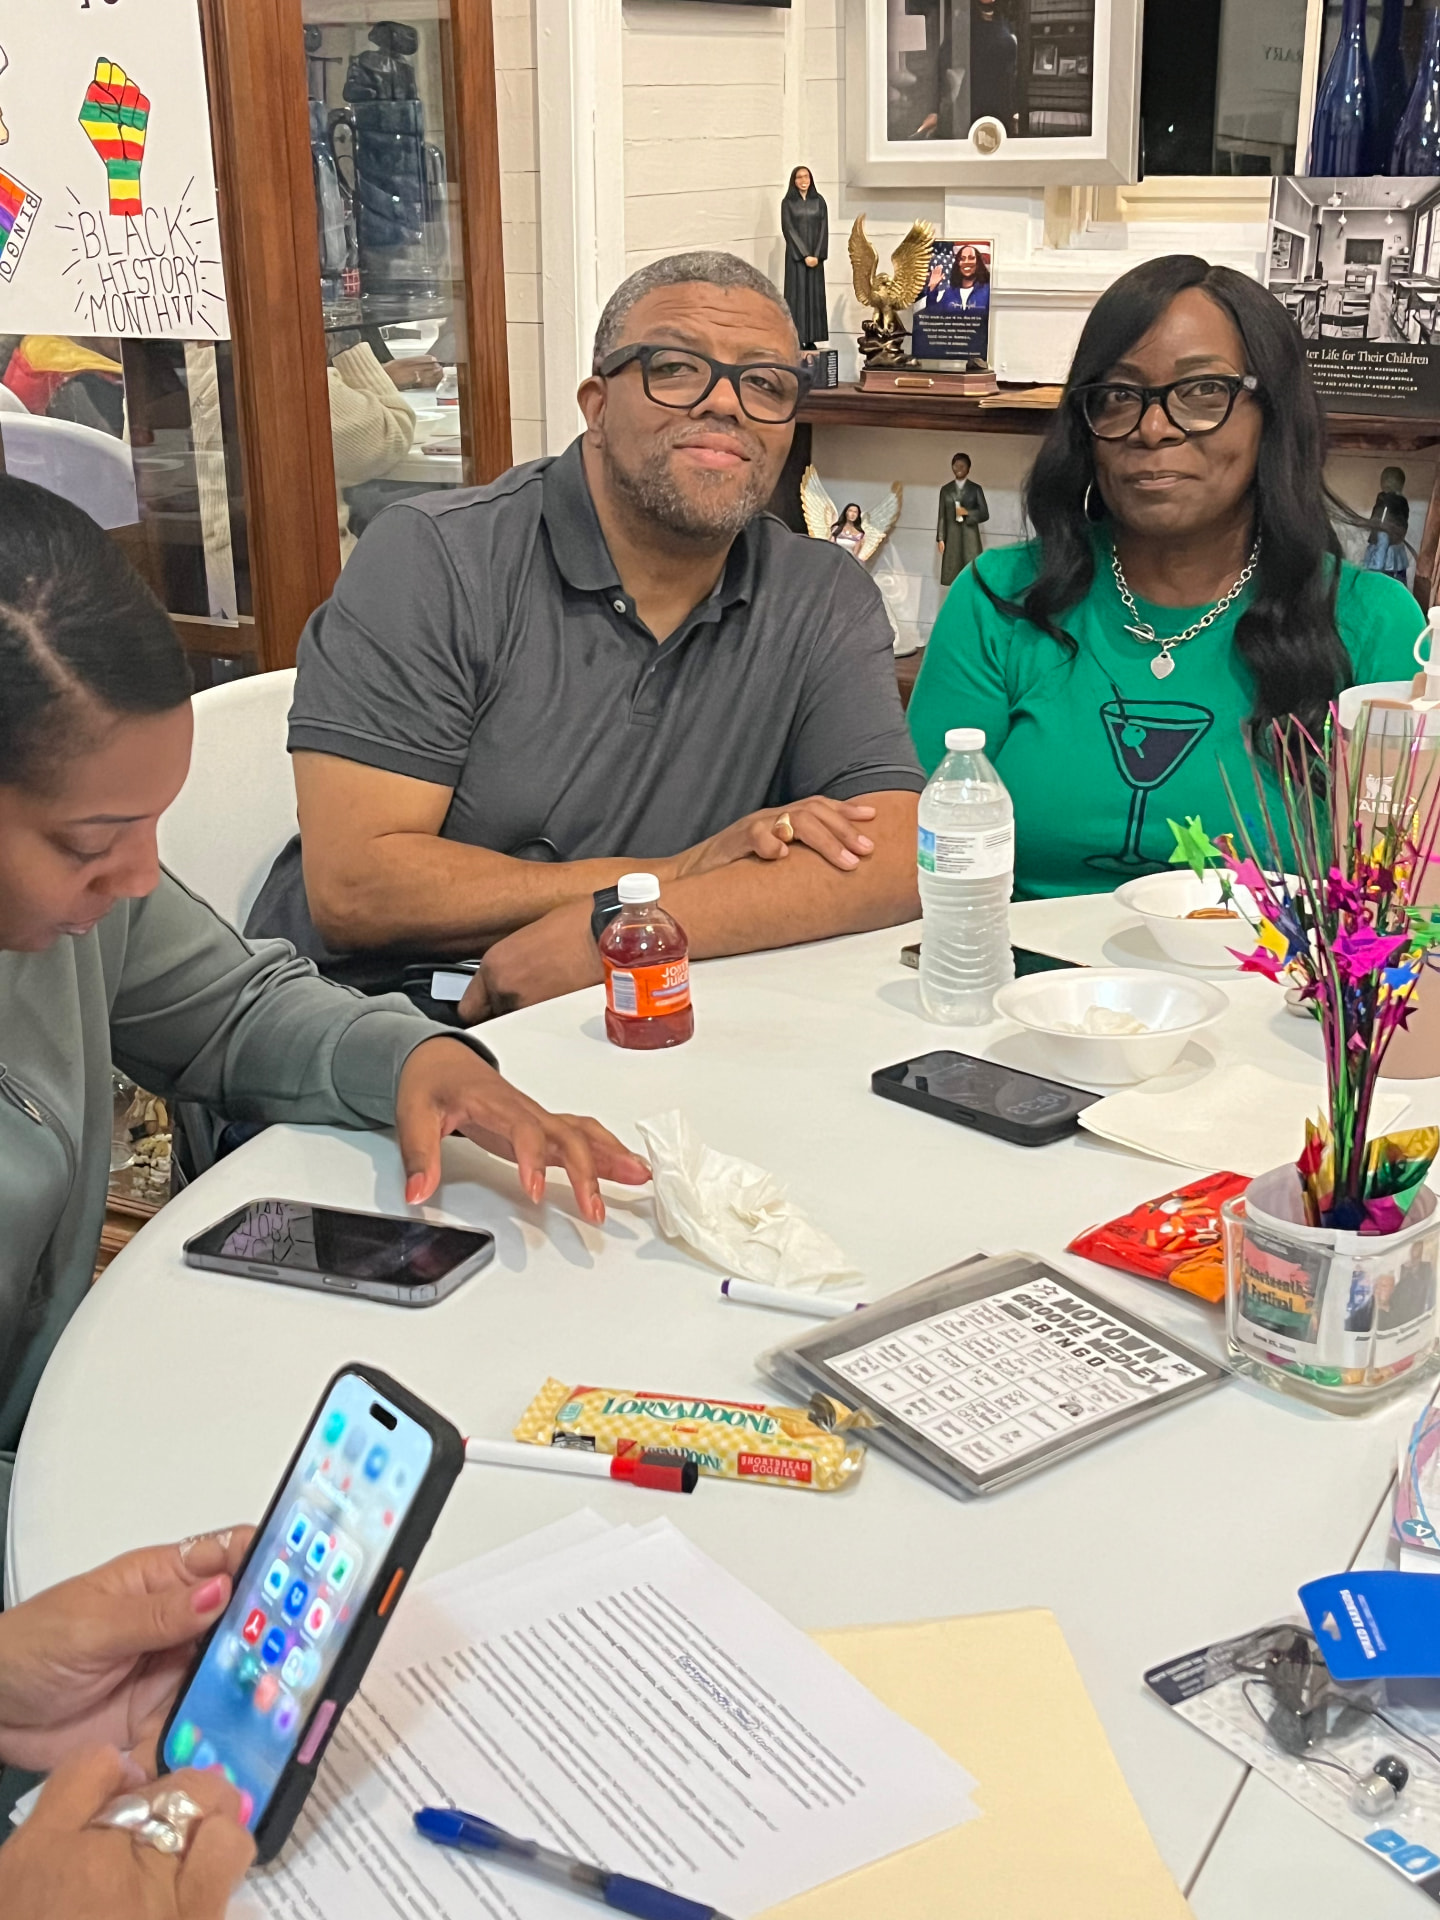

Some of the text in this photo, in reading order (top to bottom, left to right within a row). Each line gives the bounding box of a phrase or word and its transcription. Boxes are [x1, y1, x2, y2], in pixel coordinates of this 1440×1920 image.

[0, 193, 38, 275] BINGO
[78, 204, 195, 259] BLACK
[97, 255, 199, 295] HISTORY
[1321, 348, 1340, 361] Life
[1341, 349, 1356, 361] for
[1357, 350, 1385, 363] Their
[1385, 352, 1429, 365] Children
[1011, 1293, 1169, 1385] GROOVE MEDLEY
[1049, 1297, 1169, 1364] MOTOWN
[740, 1455, 810, 1473] SHORTBREAD
[752, 1464, 797, 1478] COOKIES
